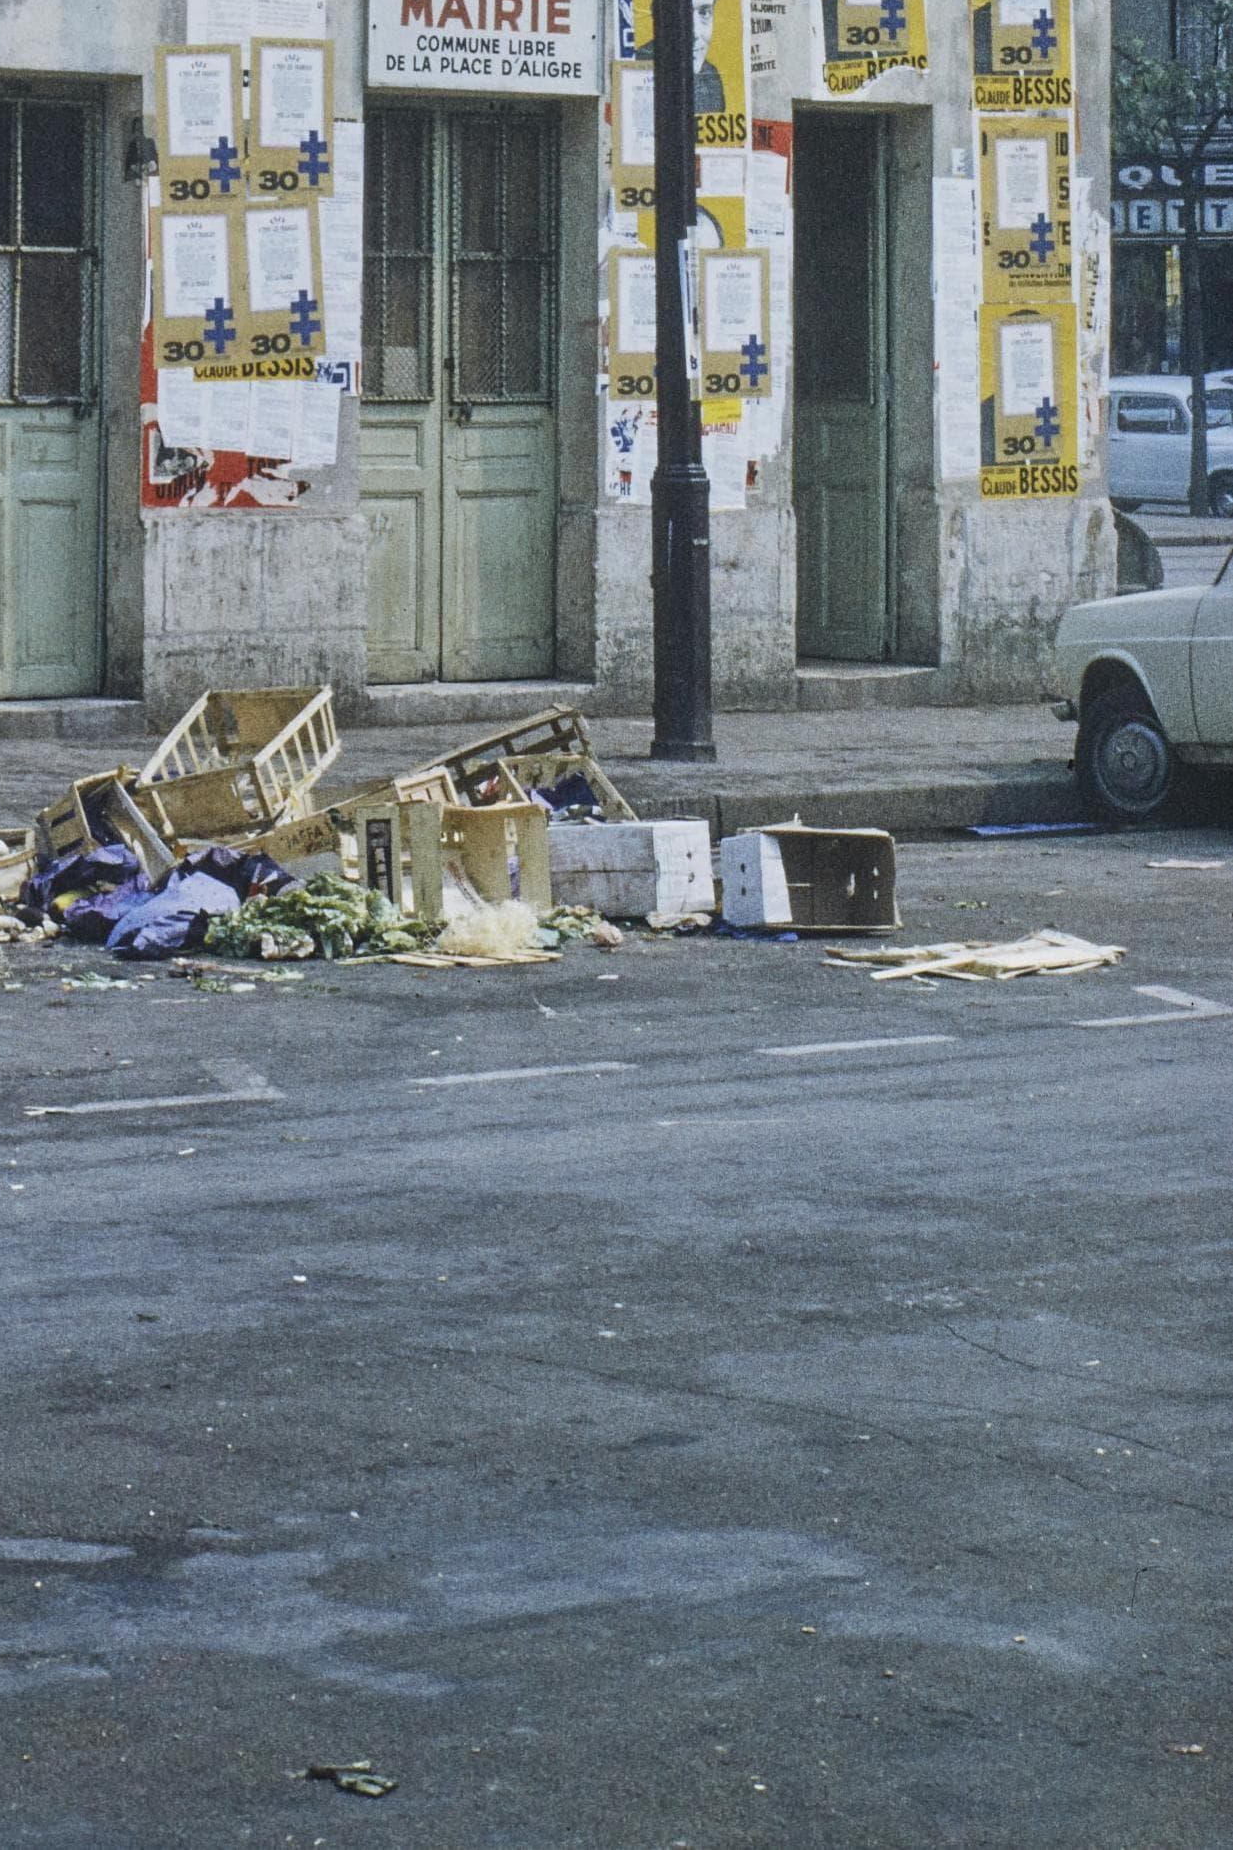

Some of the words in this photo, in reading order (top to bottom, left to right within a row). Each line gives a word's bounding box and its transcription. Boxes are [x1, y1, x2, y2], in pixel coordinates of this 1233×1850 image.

[846, 26, 880, 45] 30
[417, 35, 500, 54] COMMUNE
[509, 39, 555, 57] LIBRE
[1000, 46, 1032, 65] 30
[386, 55, 405, 71] DE
[413, 56, 432, 72] LA
[441, 57, 492, 75] PLACE
[502, 59, 582, 78] D'ALIGRE
[1013, 78, 1072, 104] BESSIS
[695, 113, 747, 144] ESSIS
[170, 180, 210, 200] 30
[259, 171, 299, 191] 30
[621, 188, 655, 207] 30
[998, 250, 1030, 269] 30
[164, 341, 205, 362] 30
[251, 333, 291, 355] 30
[618, 376, 653, 394] 30
[706, 374, 741, 394] 30
[1003, 435, 1035, 455] 30
[1019, 465, 1078, 494] BESSIS
